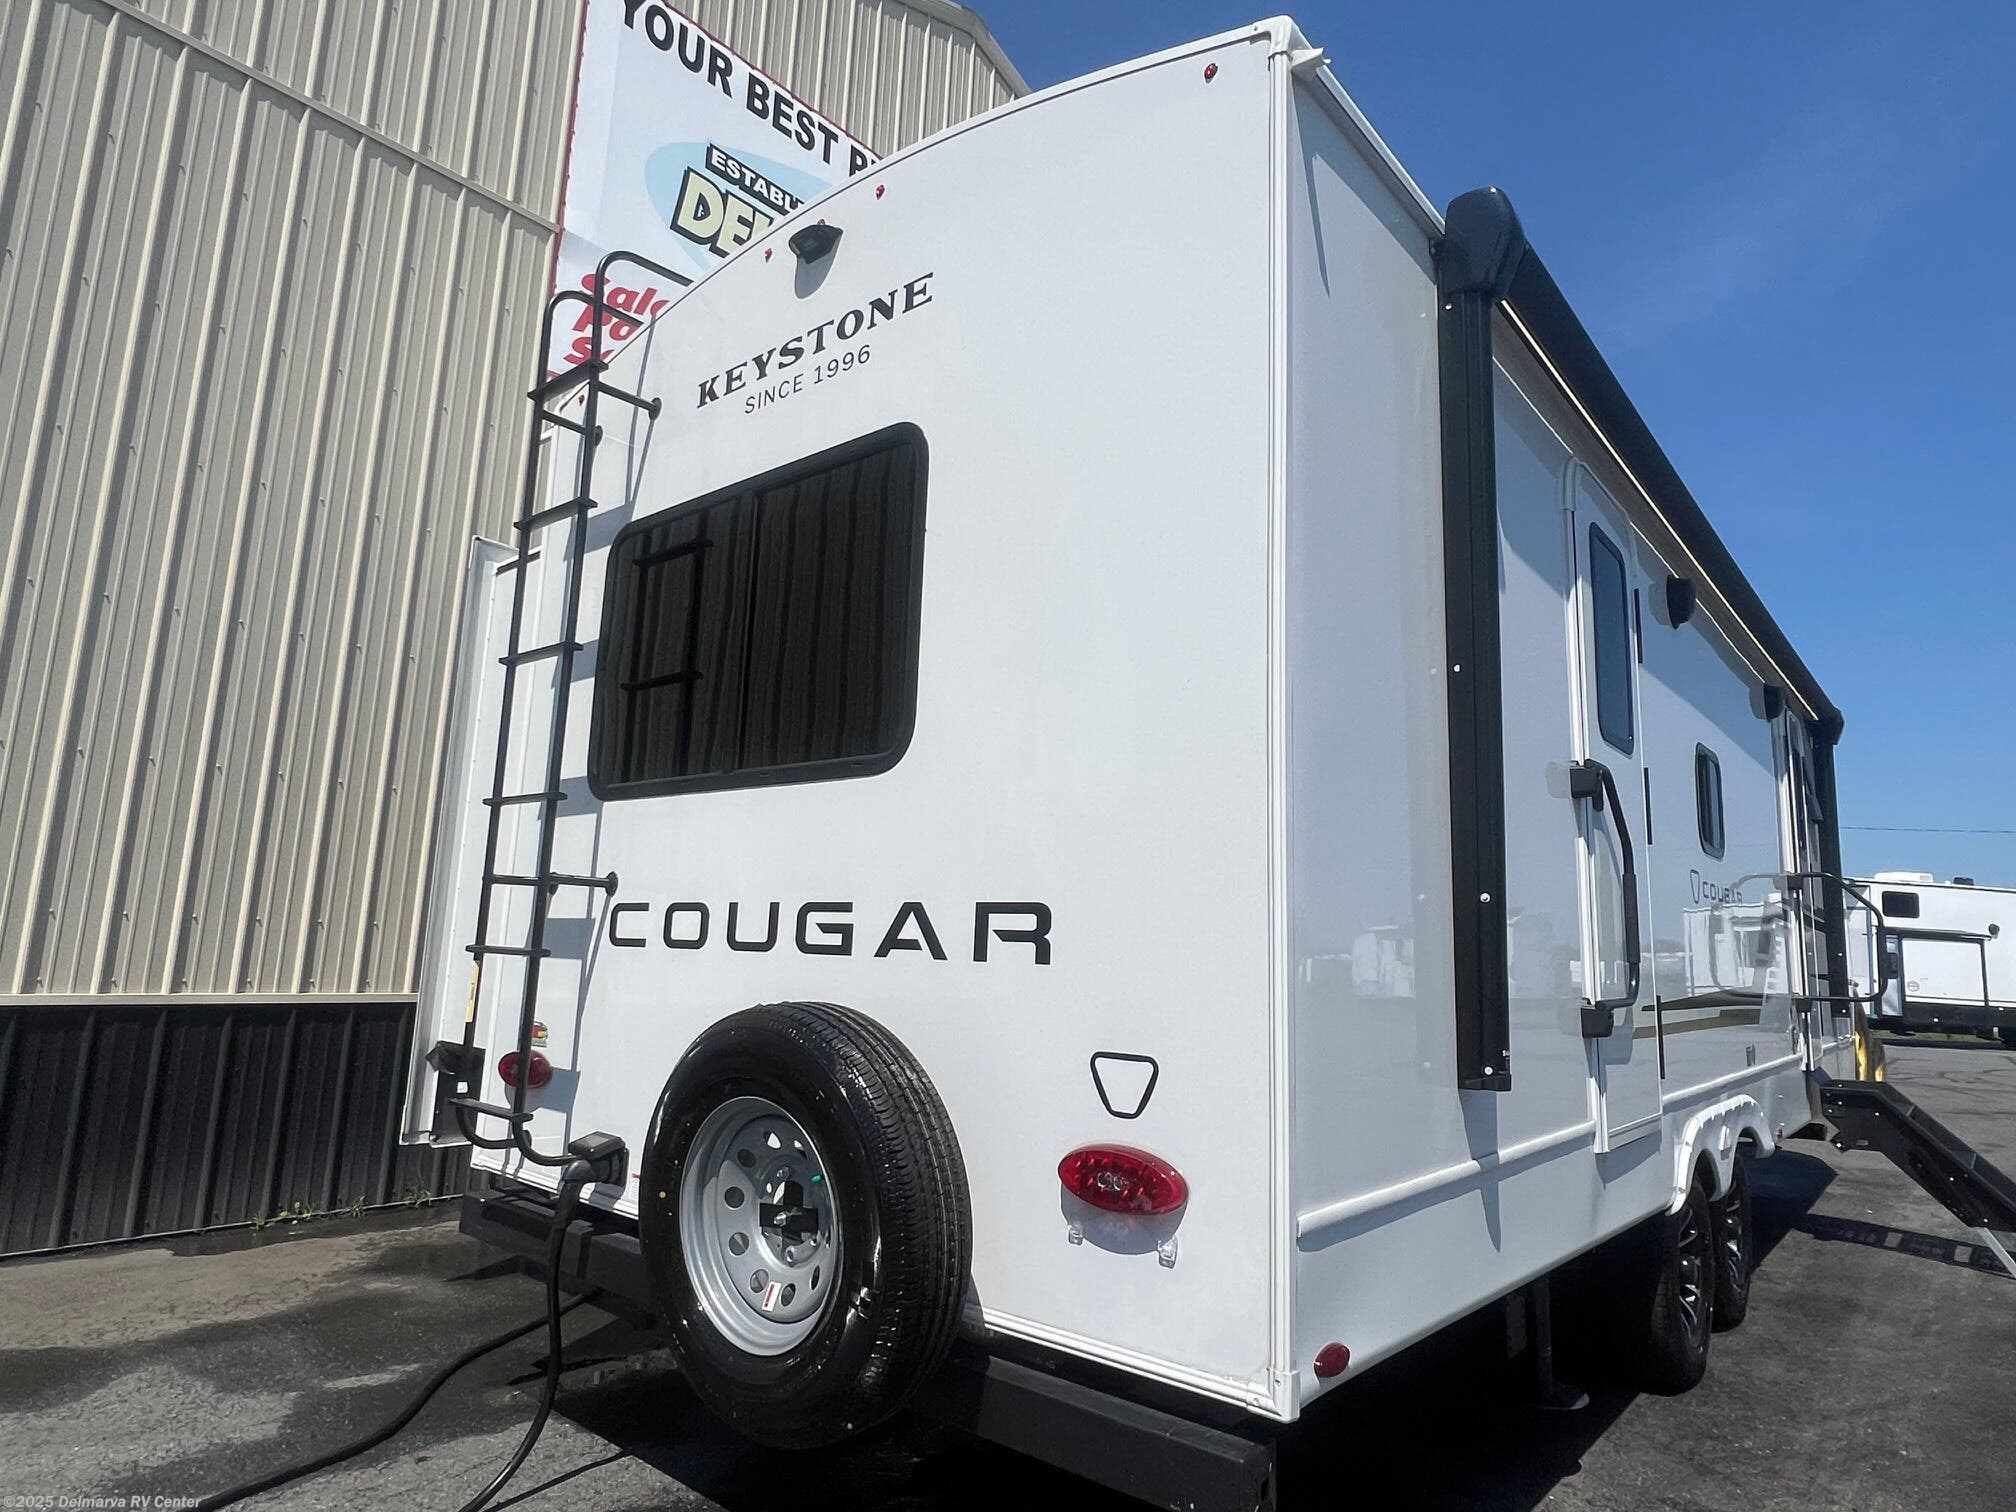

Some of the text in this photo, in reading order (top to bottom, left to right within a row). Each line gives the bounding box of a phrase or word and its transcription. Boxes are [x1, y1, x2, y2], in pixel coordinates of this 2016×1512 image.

[623, 0, 733, 99] YOUR
[746, 72, 839, 165] BEST
[697, 272, 934, 409] KEYSTONE
[744, 344, 871, 414] SINCE 1996
[609, 901, 1052, 966] COUGAR
